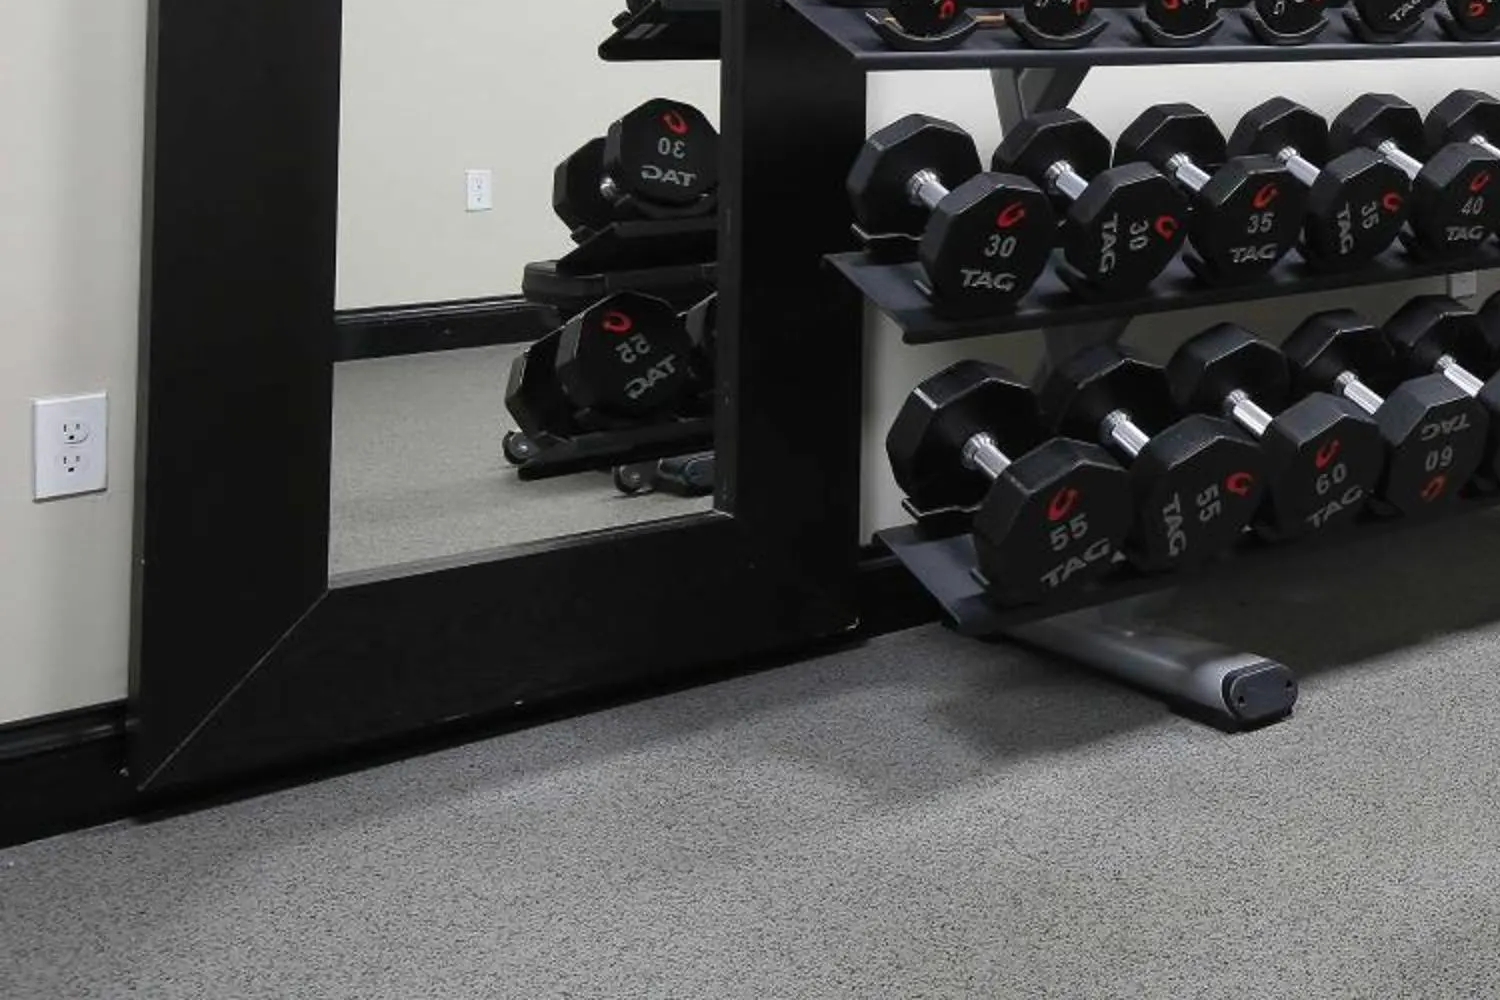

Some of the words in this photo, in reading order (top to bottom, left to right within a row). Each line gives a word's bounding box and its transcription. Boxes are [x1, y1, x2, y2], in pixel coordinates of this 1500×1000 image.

[1361, 200, 1380, 229] 35
[1461, 196, 1484, 217] 40
[1129, 219, 1149, 251] 30
[1246, 211, 1275, 234] 35
[1337, 202, 1354, 256] TAG
[1445, 225, 1485, 242] TAG
[984, 234, 1017, 258] 30
[1099, 212, 1120, 273] TAG
[1230, 243, 1278, 264] TAG
[960, 268, 1017, 292] TAG
[1421, 413, 1471, 441] TAG
[1425, 448, 1453, 472] 60
[1316, 462, 1347, 496] 60
[1197, 482, 1221, 522] 55
[1306, 484, 1362, 528] TAG
[1050, 513, 1088, 551] 55
[1162, 492, 1187, 558] TAG
[1040, 537, 1111, 588] TAG
